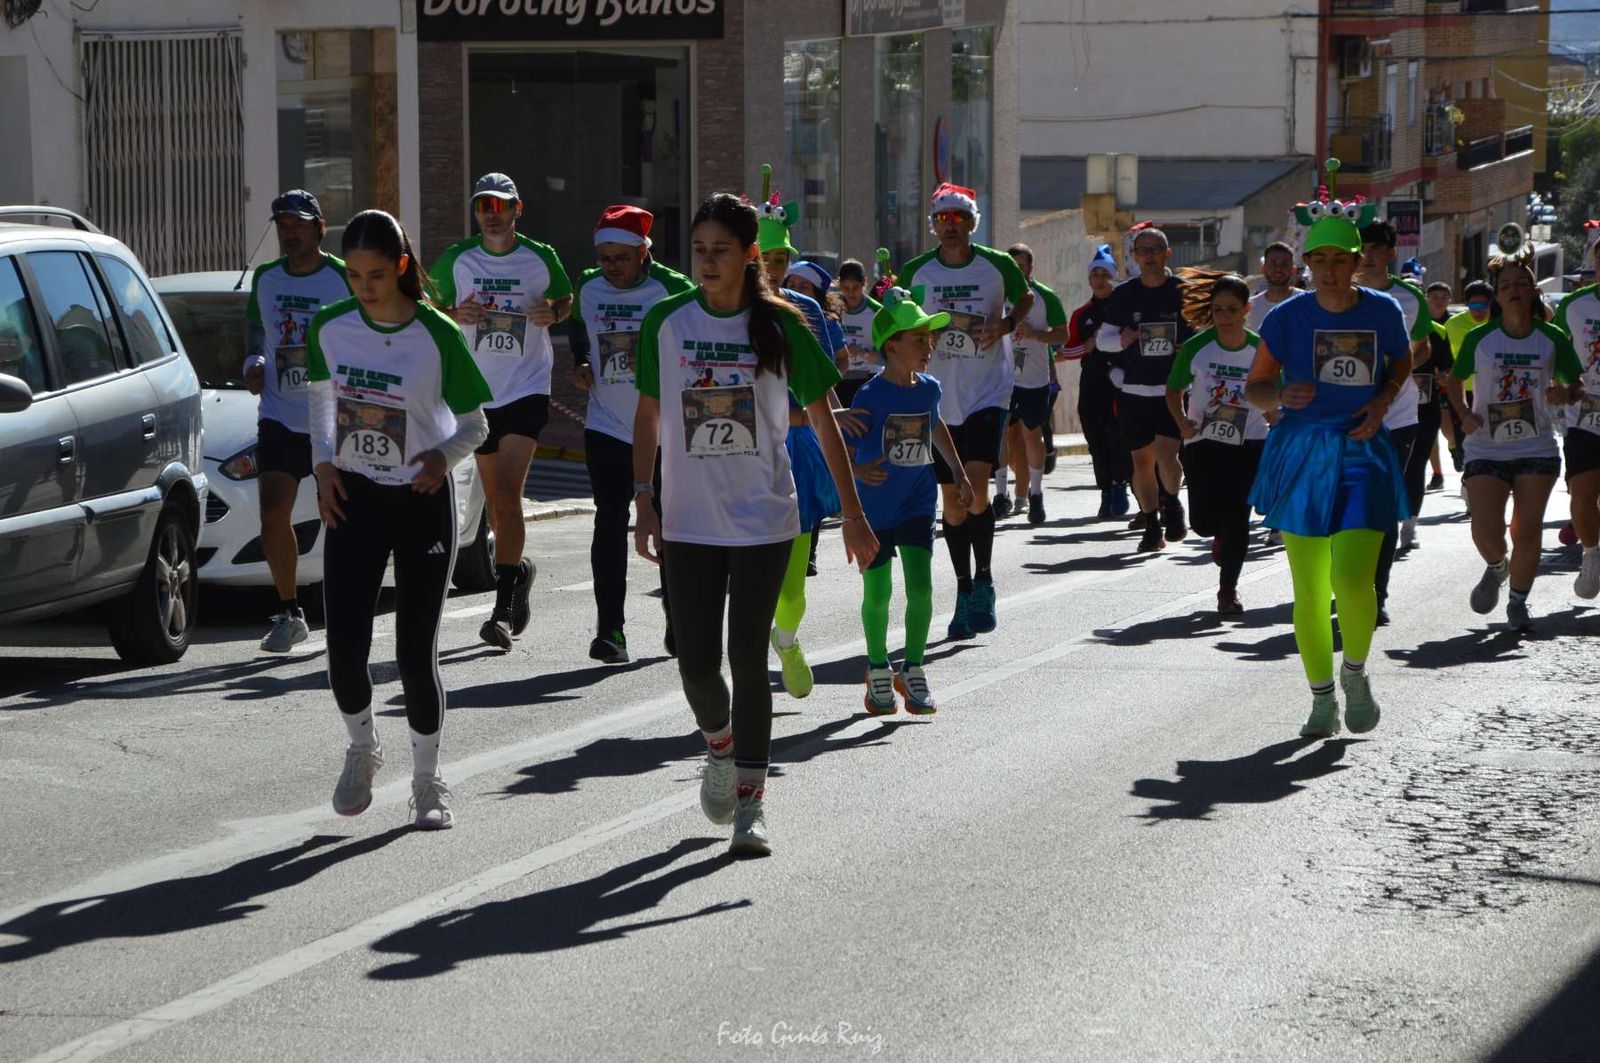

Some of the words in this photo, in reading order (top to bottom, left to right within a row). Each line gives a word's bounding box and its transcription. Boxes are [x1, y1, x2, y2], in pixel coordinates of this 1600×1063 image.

[487, 334, 514, 350] 103
[946, 332, 965, 348] 33
[1147, 340, 1168, 352] 272
[609, 355, 629, 371] 18
[1333, 360, 1356, 378] 50
[706, 423, 734, 445] 72
[1210, 422, 1235, 438] 150
[1504, 422, 1523, 436] 15
[351, 433, 389, 457] 183
[894, 442, 927, 459] 377
